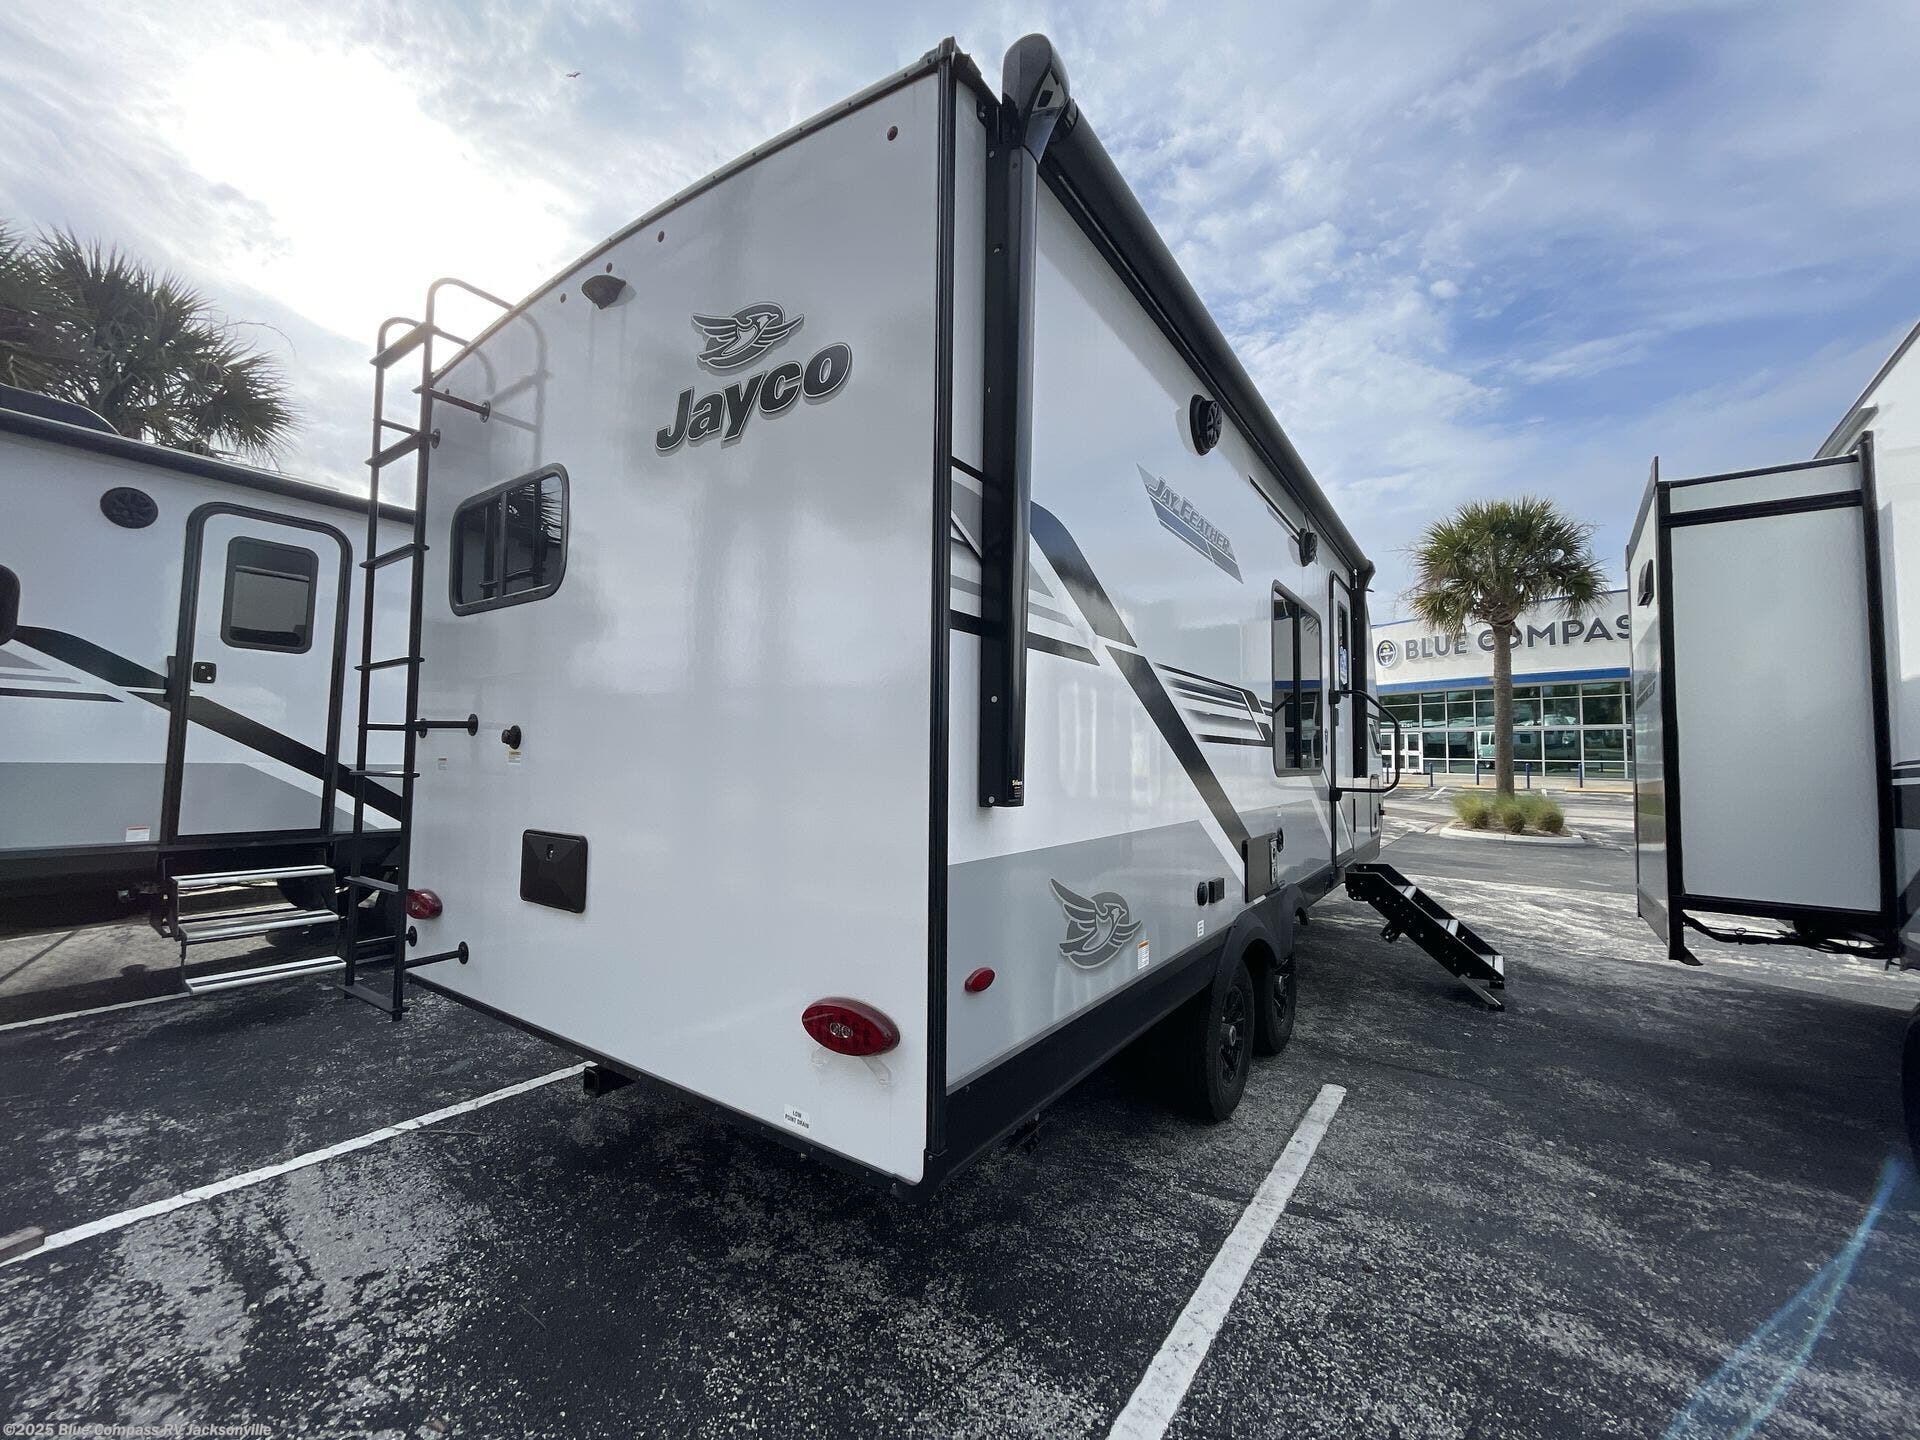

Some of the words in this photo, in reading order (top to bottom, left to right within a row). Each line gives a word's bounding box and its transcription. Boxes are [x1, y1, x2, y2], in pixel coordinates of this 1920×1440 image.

[655, 342, 852, 452] Jayco
[1146, 476, 1180, 512] JAY
[1180, 496, 1231, 554] FEATHER
[1405, 631, 1467, 660] BLUE
